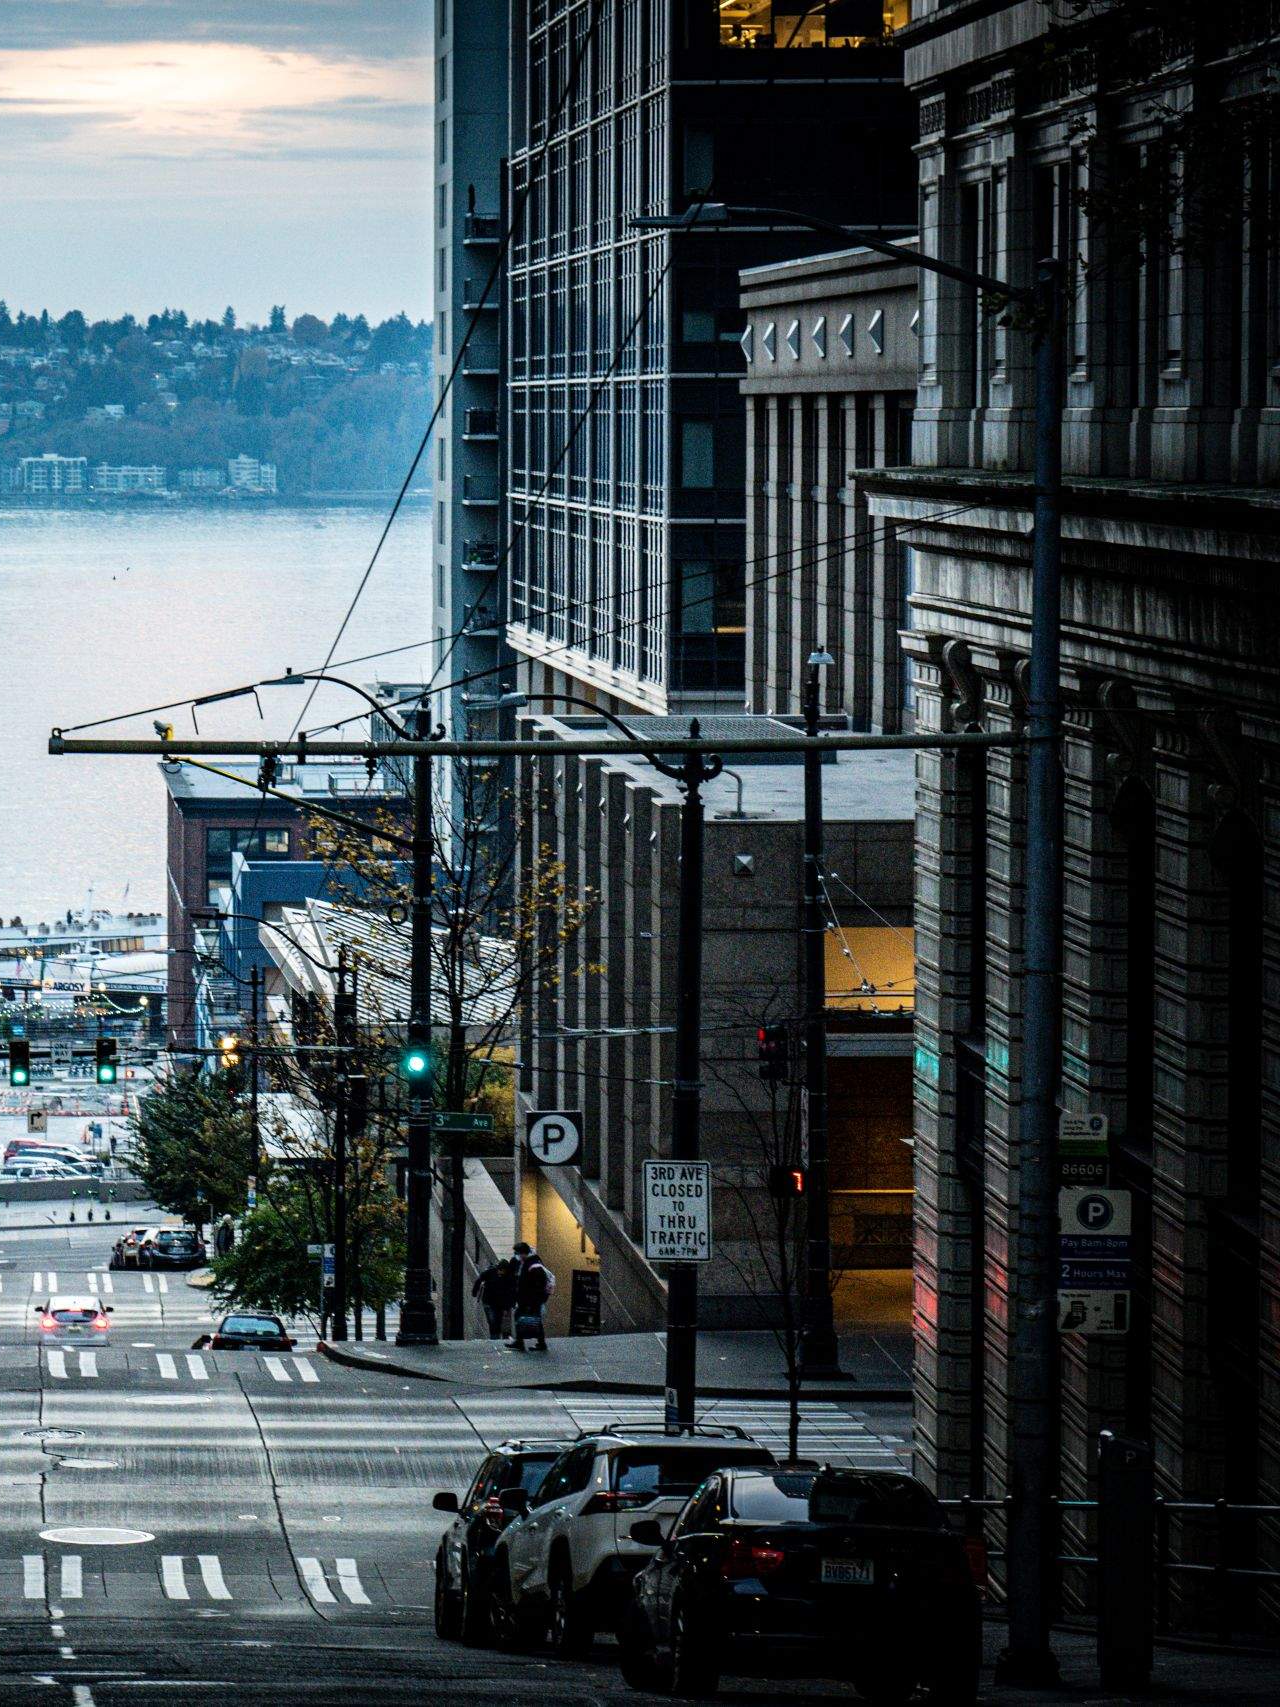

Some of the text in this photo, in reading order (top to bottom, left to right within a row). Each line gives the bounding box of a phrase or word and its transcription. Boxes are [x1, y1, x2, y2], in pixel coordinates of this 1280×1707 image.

[53, 982, 86, 992] ARGOSY
[472, 1118, 489, 1127] Ave
[543, 1123, 565, 1155] P
[651, 1166, 703, 1181] 3RD AVE
[651, 1184, 703, 1198] CLOSED
[672, 1200, 685, 1212] TO
[659, 1215, 696, 1229] THRU
[650, 1230, 706, 1246] TRAFFIC
[1061, 1238, 1079, 1249] Pay
[1061, 1264, 1128, 1279] 2 Hours Max
